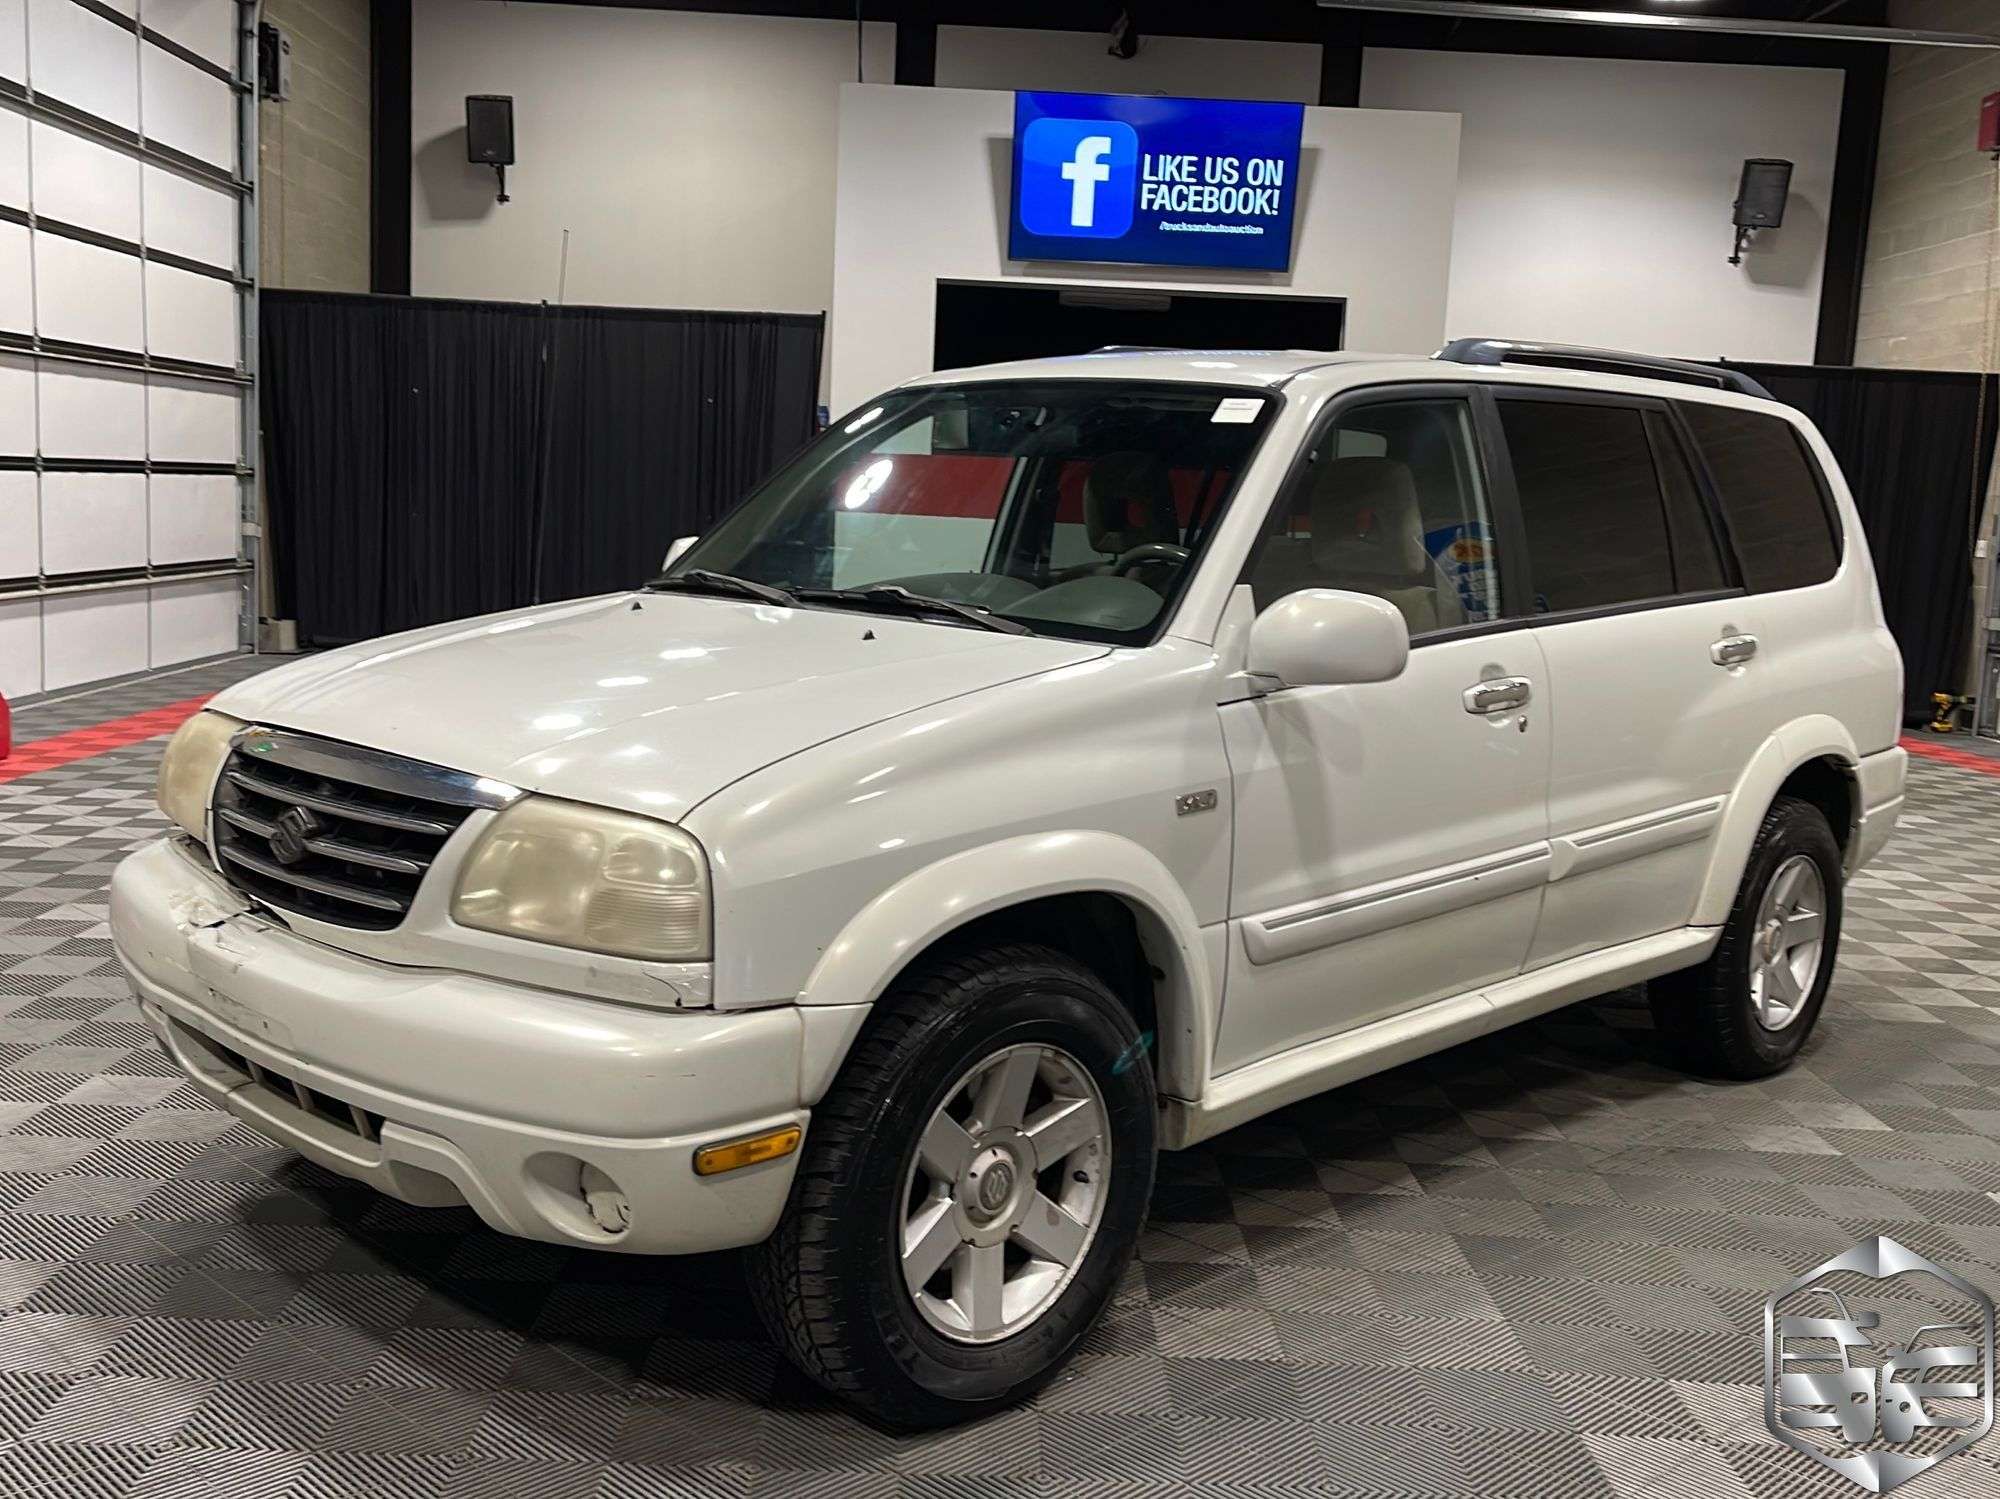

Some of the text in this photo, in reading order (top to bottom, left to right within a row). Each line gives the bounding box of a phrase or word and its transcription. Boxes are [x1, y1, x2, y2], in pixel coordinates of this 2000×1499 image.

[1061, 136, 1112, 227] f
[1142, 153, 1285, 187] LIKE US ON
[1140, 183, 1280, 216] FACEBOOK!
